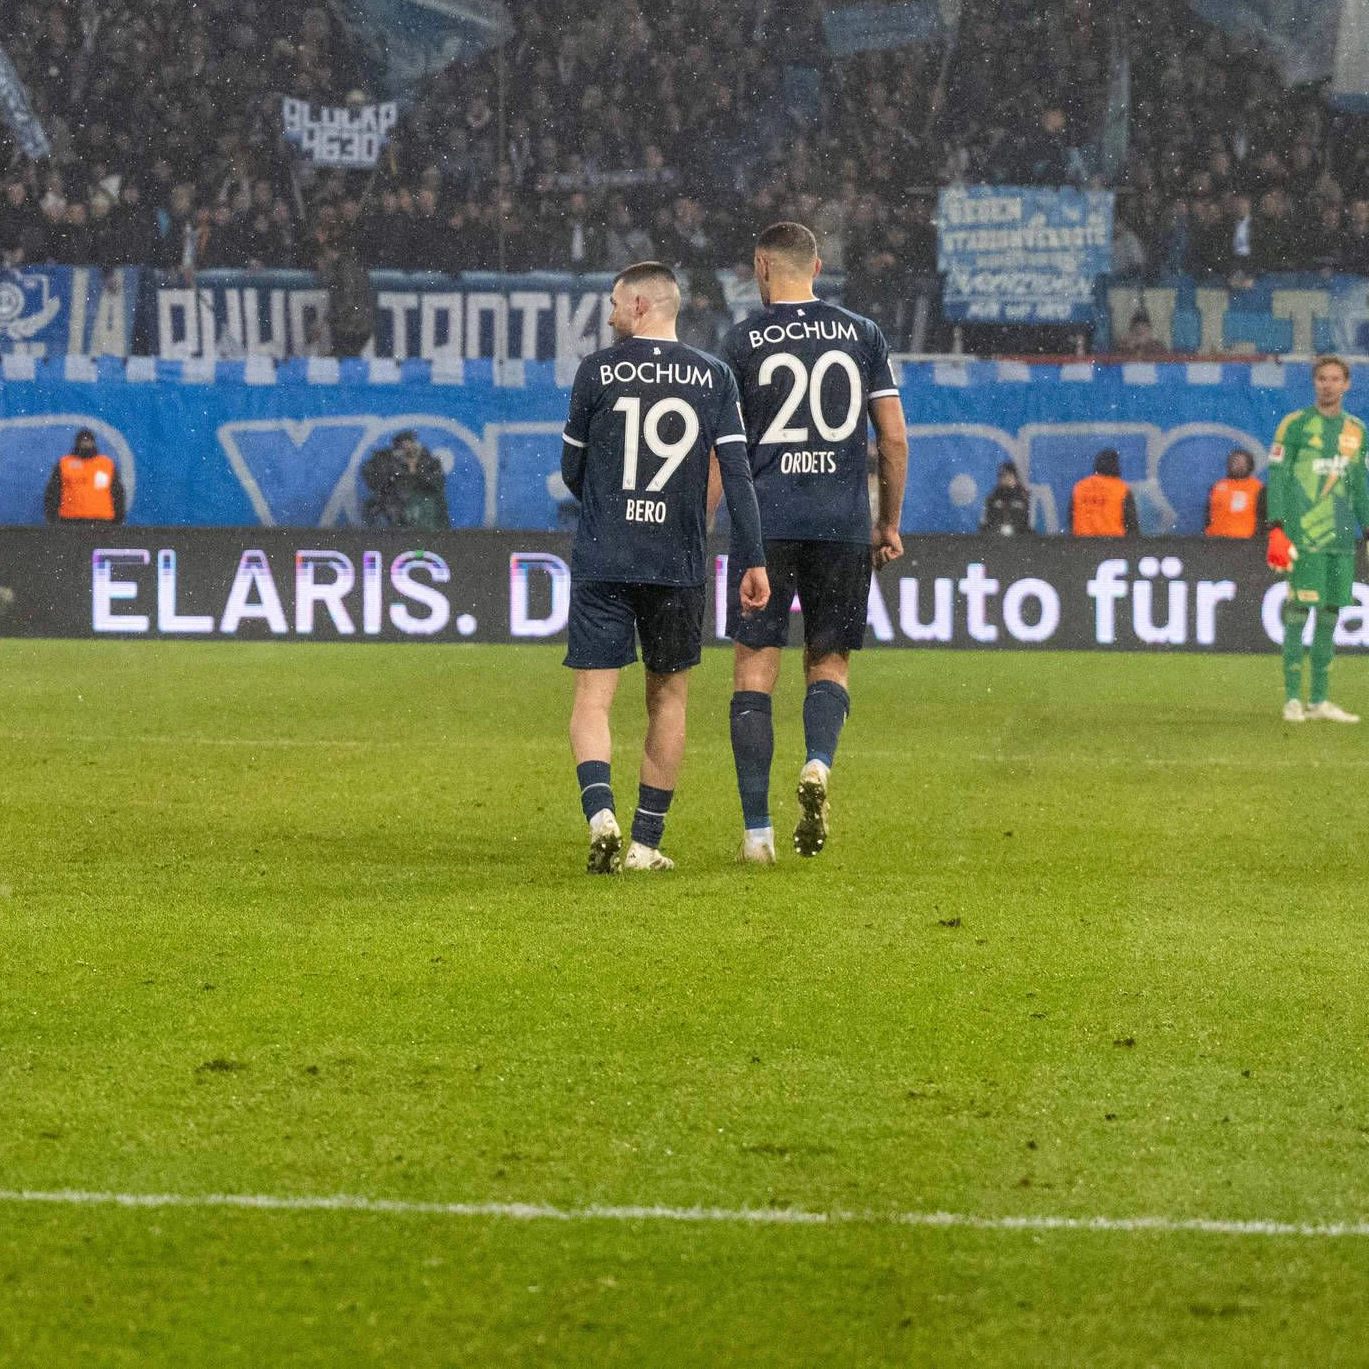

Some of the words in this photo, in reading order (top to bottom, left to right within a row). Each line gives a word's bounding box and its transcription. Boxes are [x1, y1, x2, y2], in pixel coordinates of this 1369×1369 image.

[749, 320, 859, 349] BOCHUM
[599, 361, 714, 389] BOCHUM
[758, 349, 863, 446] 20
[612, 396, 700, 493] 19
[780, 451, 837, 474] ORDETS
[625, 498, 667, 524] BERO
[92, 548, 478, 636] ELARIS.
[1086, 556, 1237, 645] für
